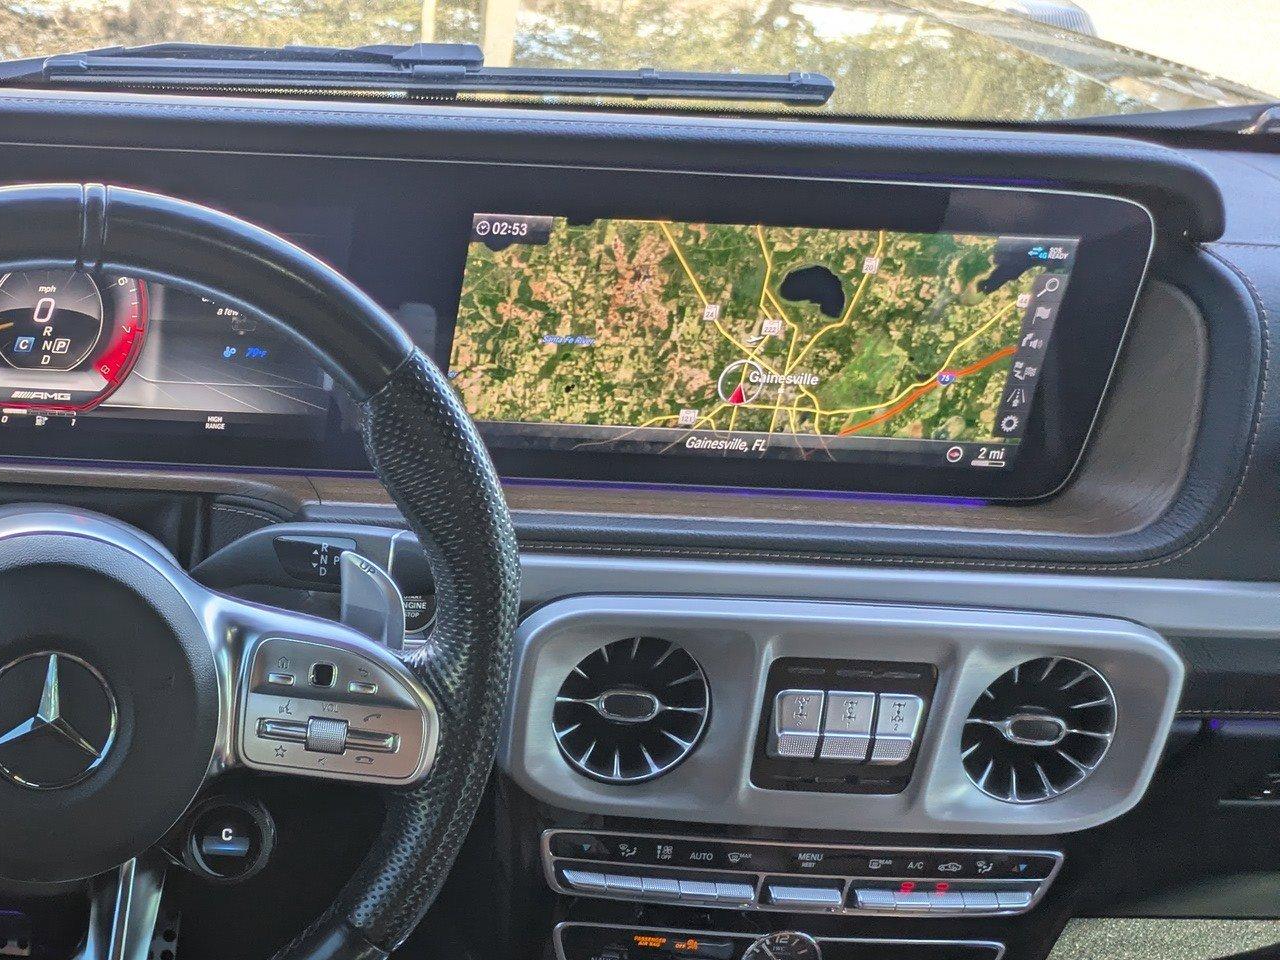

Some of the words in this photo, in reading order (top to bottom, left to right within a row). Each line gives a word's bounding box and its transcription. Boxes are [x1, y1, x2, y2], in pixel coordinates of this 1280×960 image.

[491, 221, 528, 236] 02:53
[38, 285, 57, 294] mph
[33, 297, 56, 323] 0
[42, 325, 52, 337] R
[19, 340, 29, 350] C
[542, 334, 564, 345] Santa
[565, 335, 574, 345] Fe
[42, 341, 52, 351] N
[56, 340, 67, 352] P
[40, 354, 50, 365] D
[749, 370, 819, 386] Gainesville
[32, 390, 72, 401] AMG
[207, 415, 223, 423] HIGH
[205, 422, 226, 430] RANGE
[685, 436, 749, 452] Gainesville,
[751, 438, 767, 452] FL
[977, 447, 987, 459] 2
[988, 447, 1006, 459] mi
[321, 542, 329, 552] R
[320, 554, 328, 565] N
[319, 566, 327, 576] D
[360, 561, 377, 575] UP
[402, 601, 428, 610] NGINE
[221, 828, 233, 841] C
[689, 852, 714, 861] AUTO
[798, 852, 824, 861] MENU
[907, 861, 924, 870] A/C
